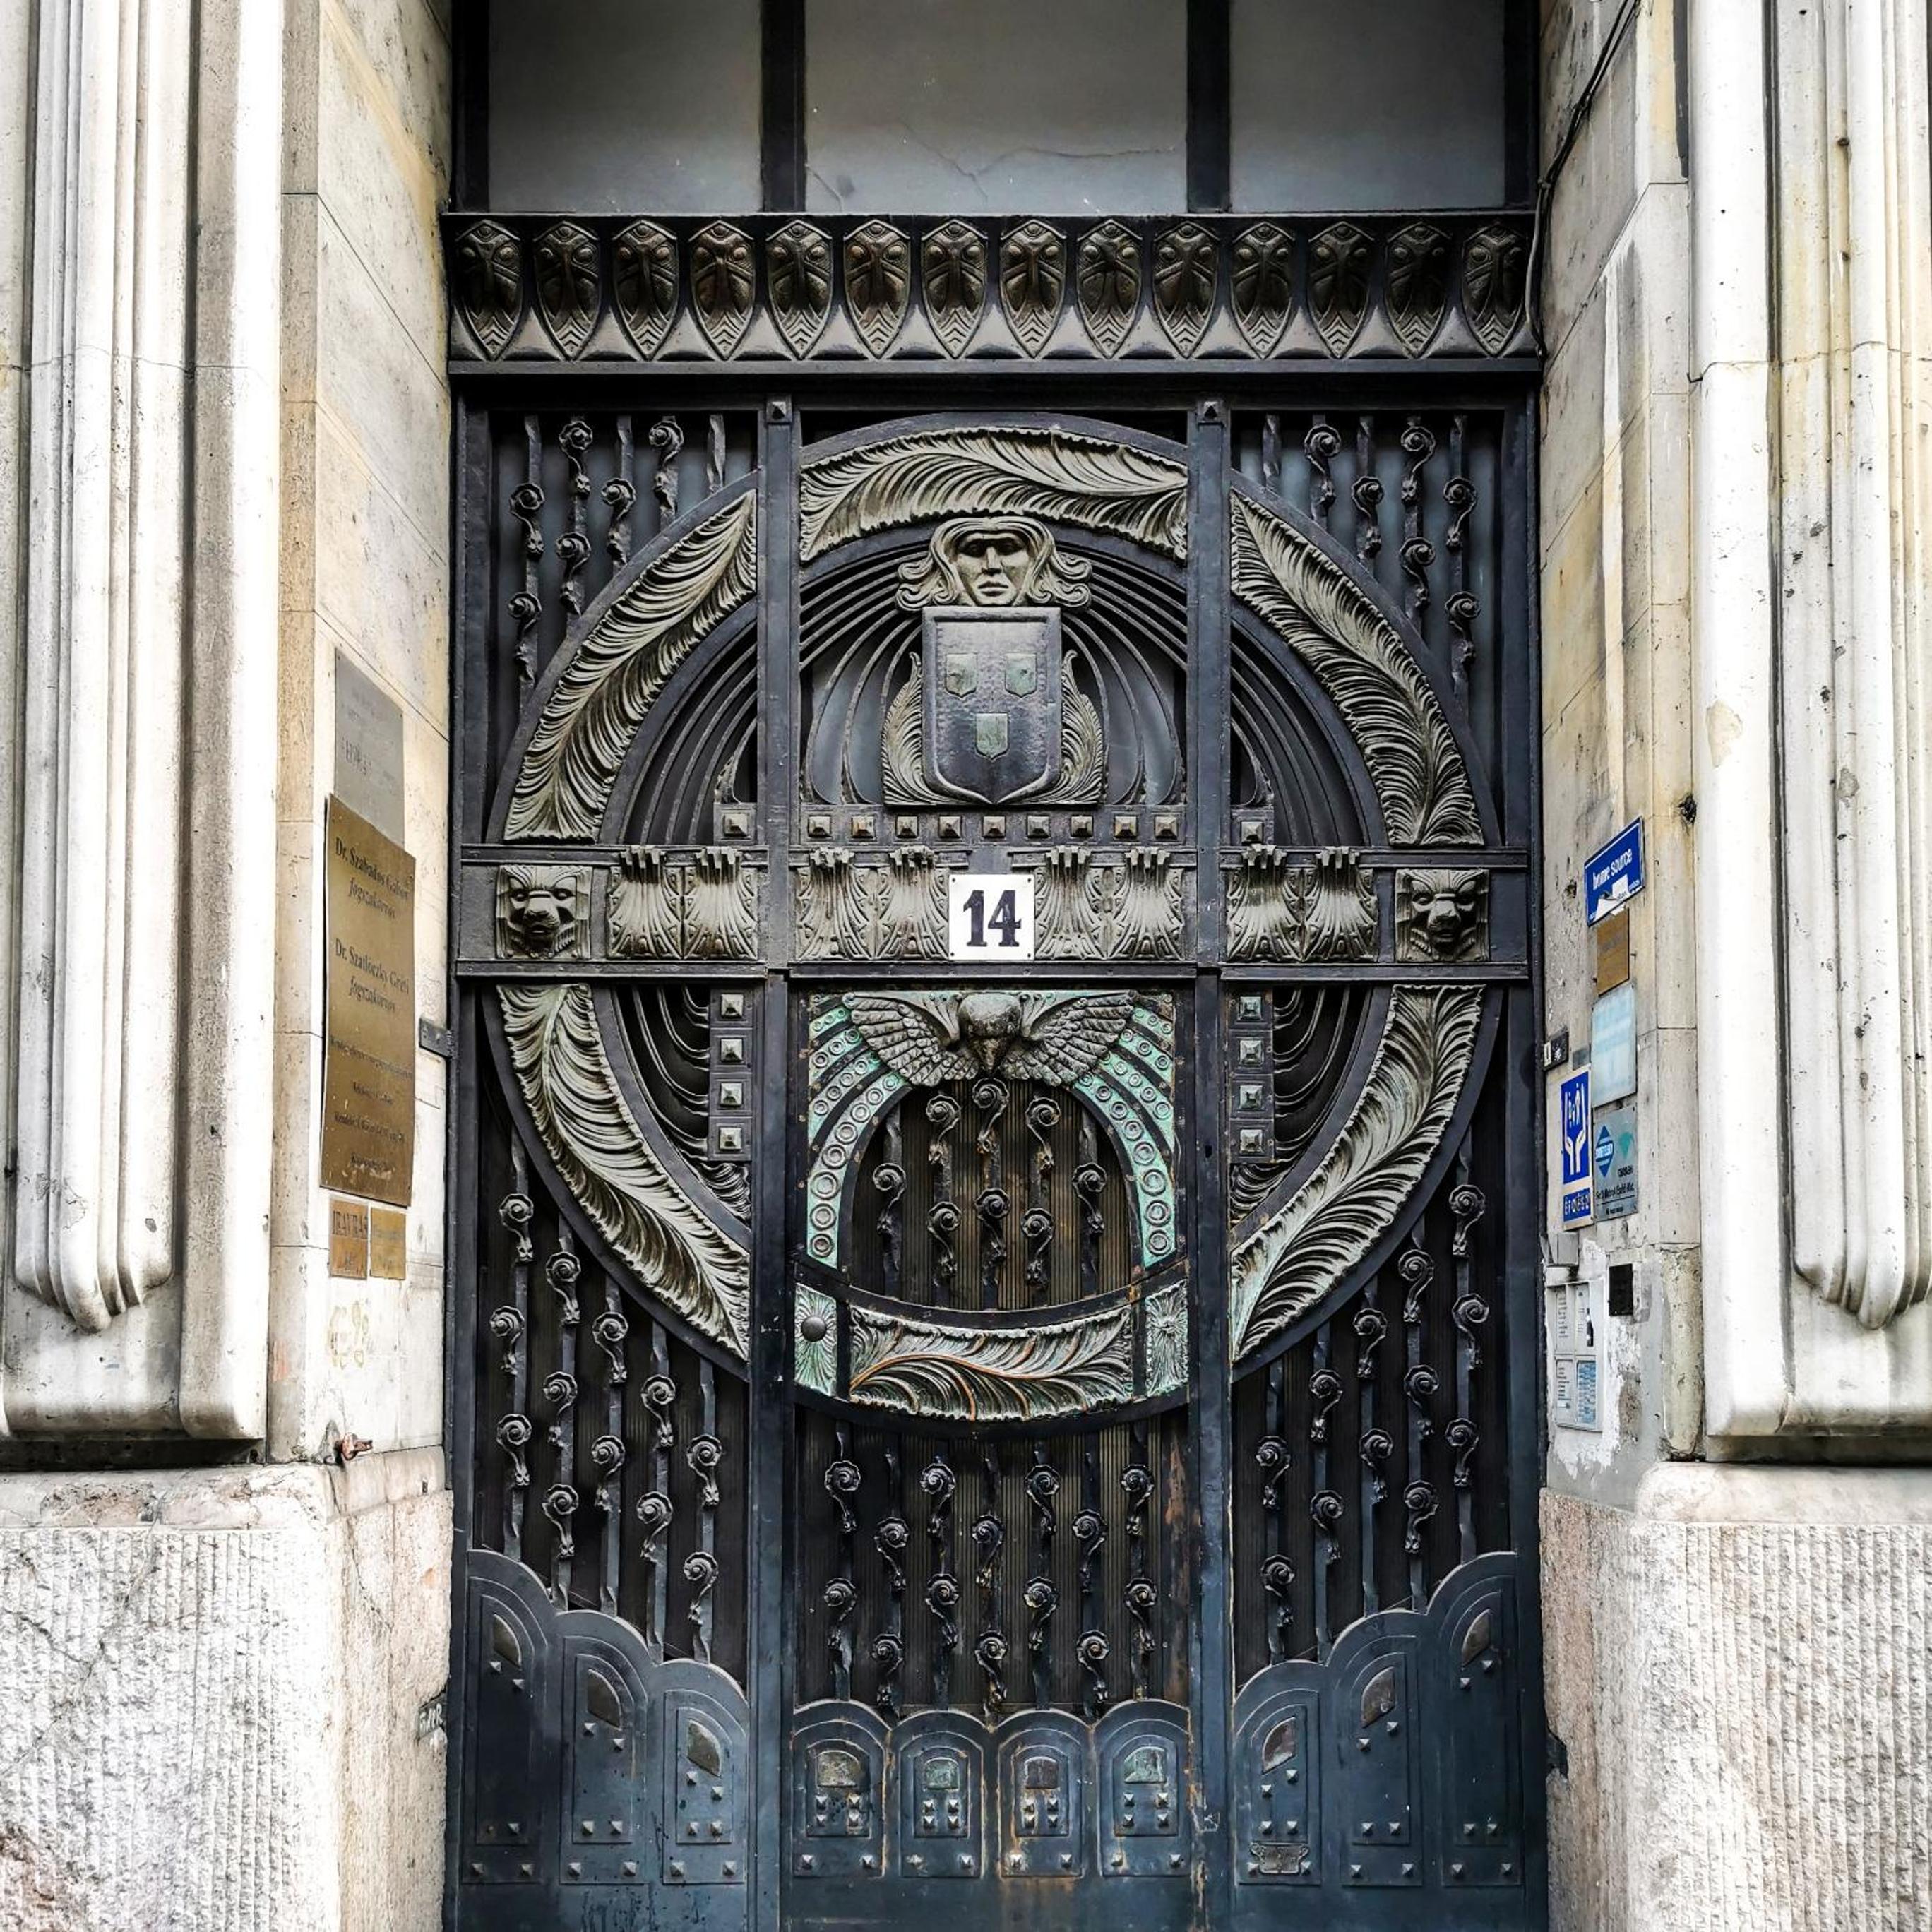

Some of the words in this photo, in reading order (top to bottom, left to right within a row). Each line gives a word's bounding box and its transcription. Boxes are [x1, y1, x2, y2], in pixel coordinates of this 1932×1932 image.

[335, 837, 348, 861] Dr.
[1611, 848, 1633, 876] source
[962, 890, 1022, 947] 14
[335, 938, 347, 960] Dr.
